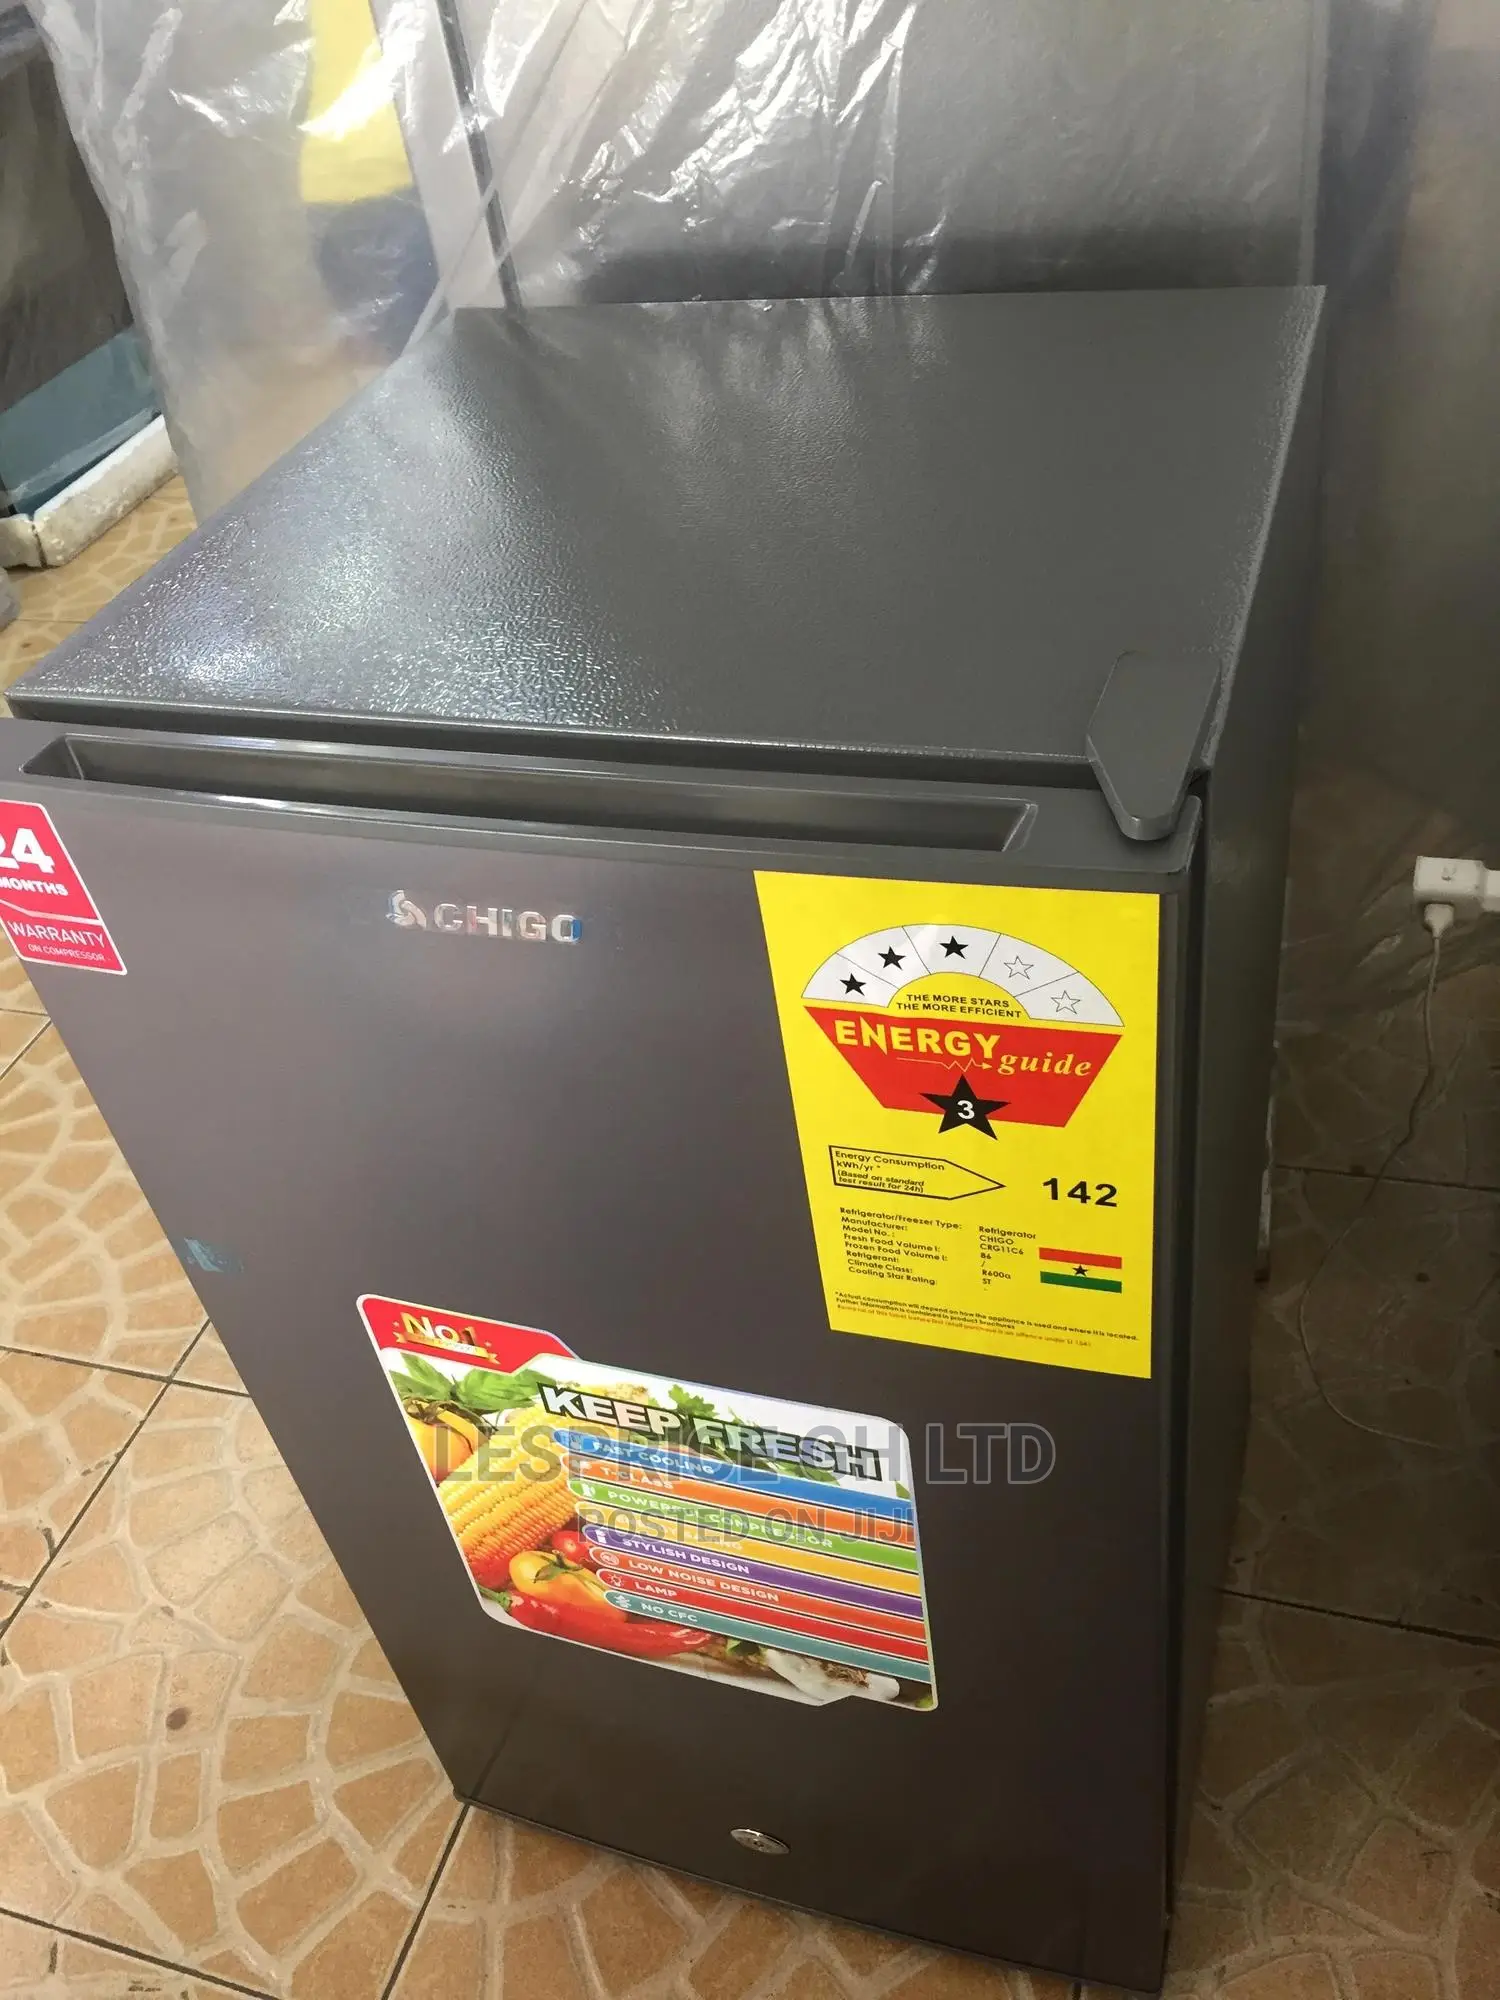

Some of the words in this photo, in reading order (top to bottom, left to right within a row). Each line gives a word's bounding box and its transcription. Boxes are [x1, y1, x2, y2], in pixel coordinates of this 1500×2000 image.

[0, 876, 69, 897] MONTHS
[434, 903, 583, 943] CHIGO
[7, 920, 106, 948] WARRANTY
[28, 943, 42, 953] ON
[896, 1002, 920, 1011] THE
[922, 1003, 957, 1013] MORE
[960, 1006, 1022, 1018] EFFICIENT
[906, 994, 930, 1002] THE
[933, 994, 967, 1004] MORE
[971, 997, 1010, 1008] STARS
[834, 1015, 1001, 1060] ENERGY
[997, 1050, 1094, 1077] guide
[956, 1099, 977, 1121] 3
[835, 1150, 871, 1163] Energy
[873, 1155, 946, 1171] Consumption
[836, 1160, 873, 1172] kWh/yr
[837, 1169, 869, 1180] (Based
[885, 1176, 925, 1187] standard
[839, 1176, 856, 1184] test
[858, 1179, 886, 1188] result
[887, 1181, 902, 1190] for
[904, 1184, 924, 1194] 24h)
[1042, 1177, 1118, 1207] 142
[841, 1216, 908, 1231] Manufacturer:
[842, 1224, 872, 1235] Model
[979, 1225, 1036, 1239] Refrigerator
[843, 1233, 868, 1242] Fresh
[870, 1236, 894, 1246] Food
[896, 1240, 933, 1252] Volume
[979, 1234, 1014, 1245] CHIGO
[844, 1241, 875, 1251] Frozen
[878, 1245, 901, 1255] Food
[904, 1250, 941, 1260] Volume
[847, 1258, 884, 1270] Climate
[848, 1266, 885, 1279] Cooling
[887, 1271, 905, 1280] Star
[982, 1269, 1012, 1280] R600a
[538, 1384, 684, 1437] KEEP
[693, 1416, 882, 1481] FRESH
[593, 1441, 633, 1457] FAST
[639, 1450, 714, 1475] COOLING
[622, 1539, 687, 1560] STYLISH
[690, 1553, 750, 1574] DESIGN
[628, 1559, 664, 1575] LOW
[668, 1567, 717, 1588] NOISE
[719, 1581, 780, 1602] DESIGN
[635, 1581, 678, 1598] LAMP
[641, 1602, 665, 1615] NO
[667, 1609, 699, 1623] CFC
